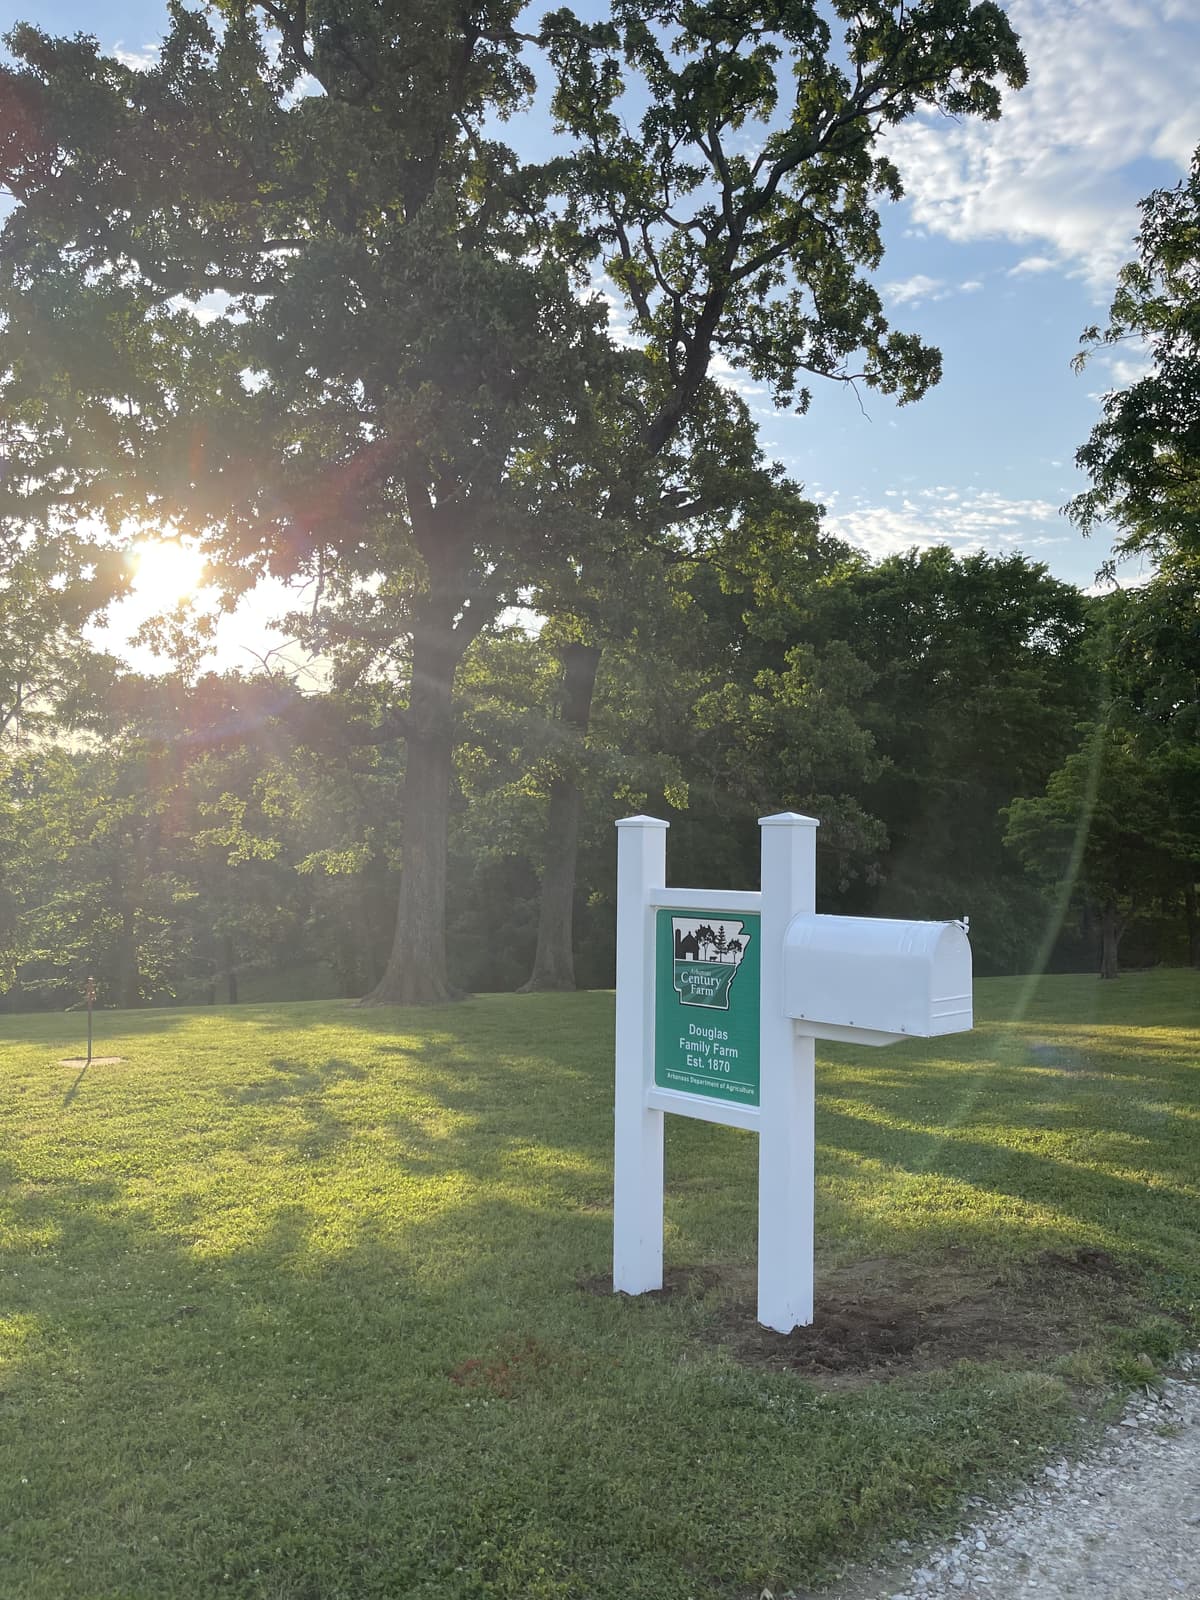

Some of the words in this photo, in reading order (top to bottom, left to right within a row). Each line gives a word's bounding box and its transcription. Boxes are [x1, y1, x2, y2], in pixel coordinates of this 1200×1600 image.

[681, 971, 721, 990] Century
[691, 984, 714, 997] Farm
[689, 1023, 728, 1041] Douglas
[679, 1037, 710, 1056] Family
[713, 1042, 738, 1058] Farm
[687, 1054, 704, 1068] Est.
[708, 1058, 730, 1073] 1870
[667, 1072, 690, 1082] Arkansas
[690, 1076, 720, 1089] Department
[726, 1083, 754, 1095] Agriculture
